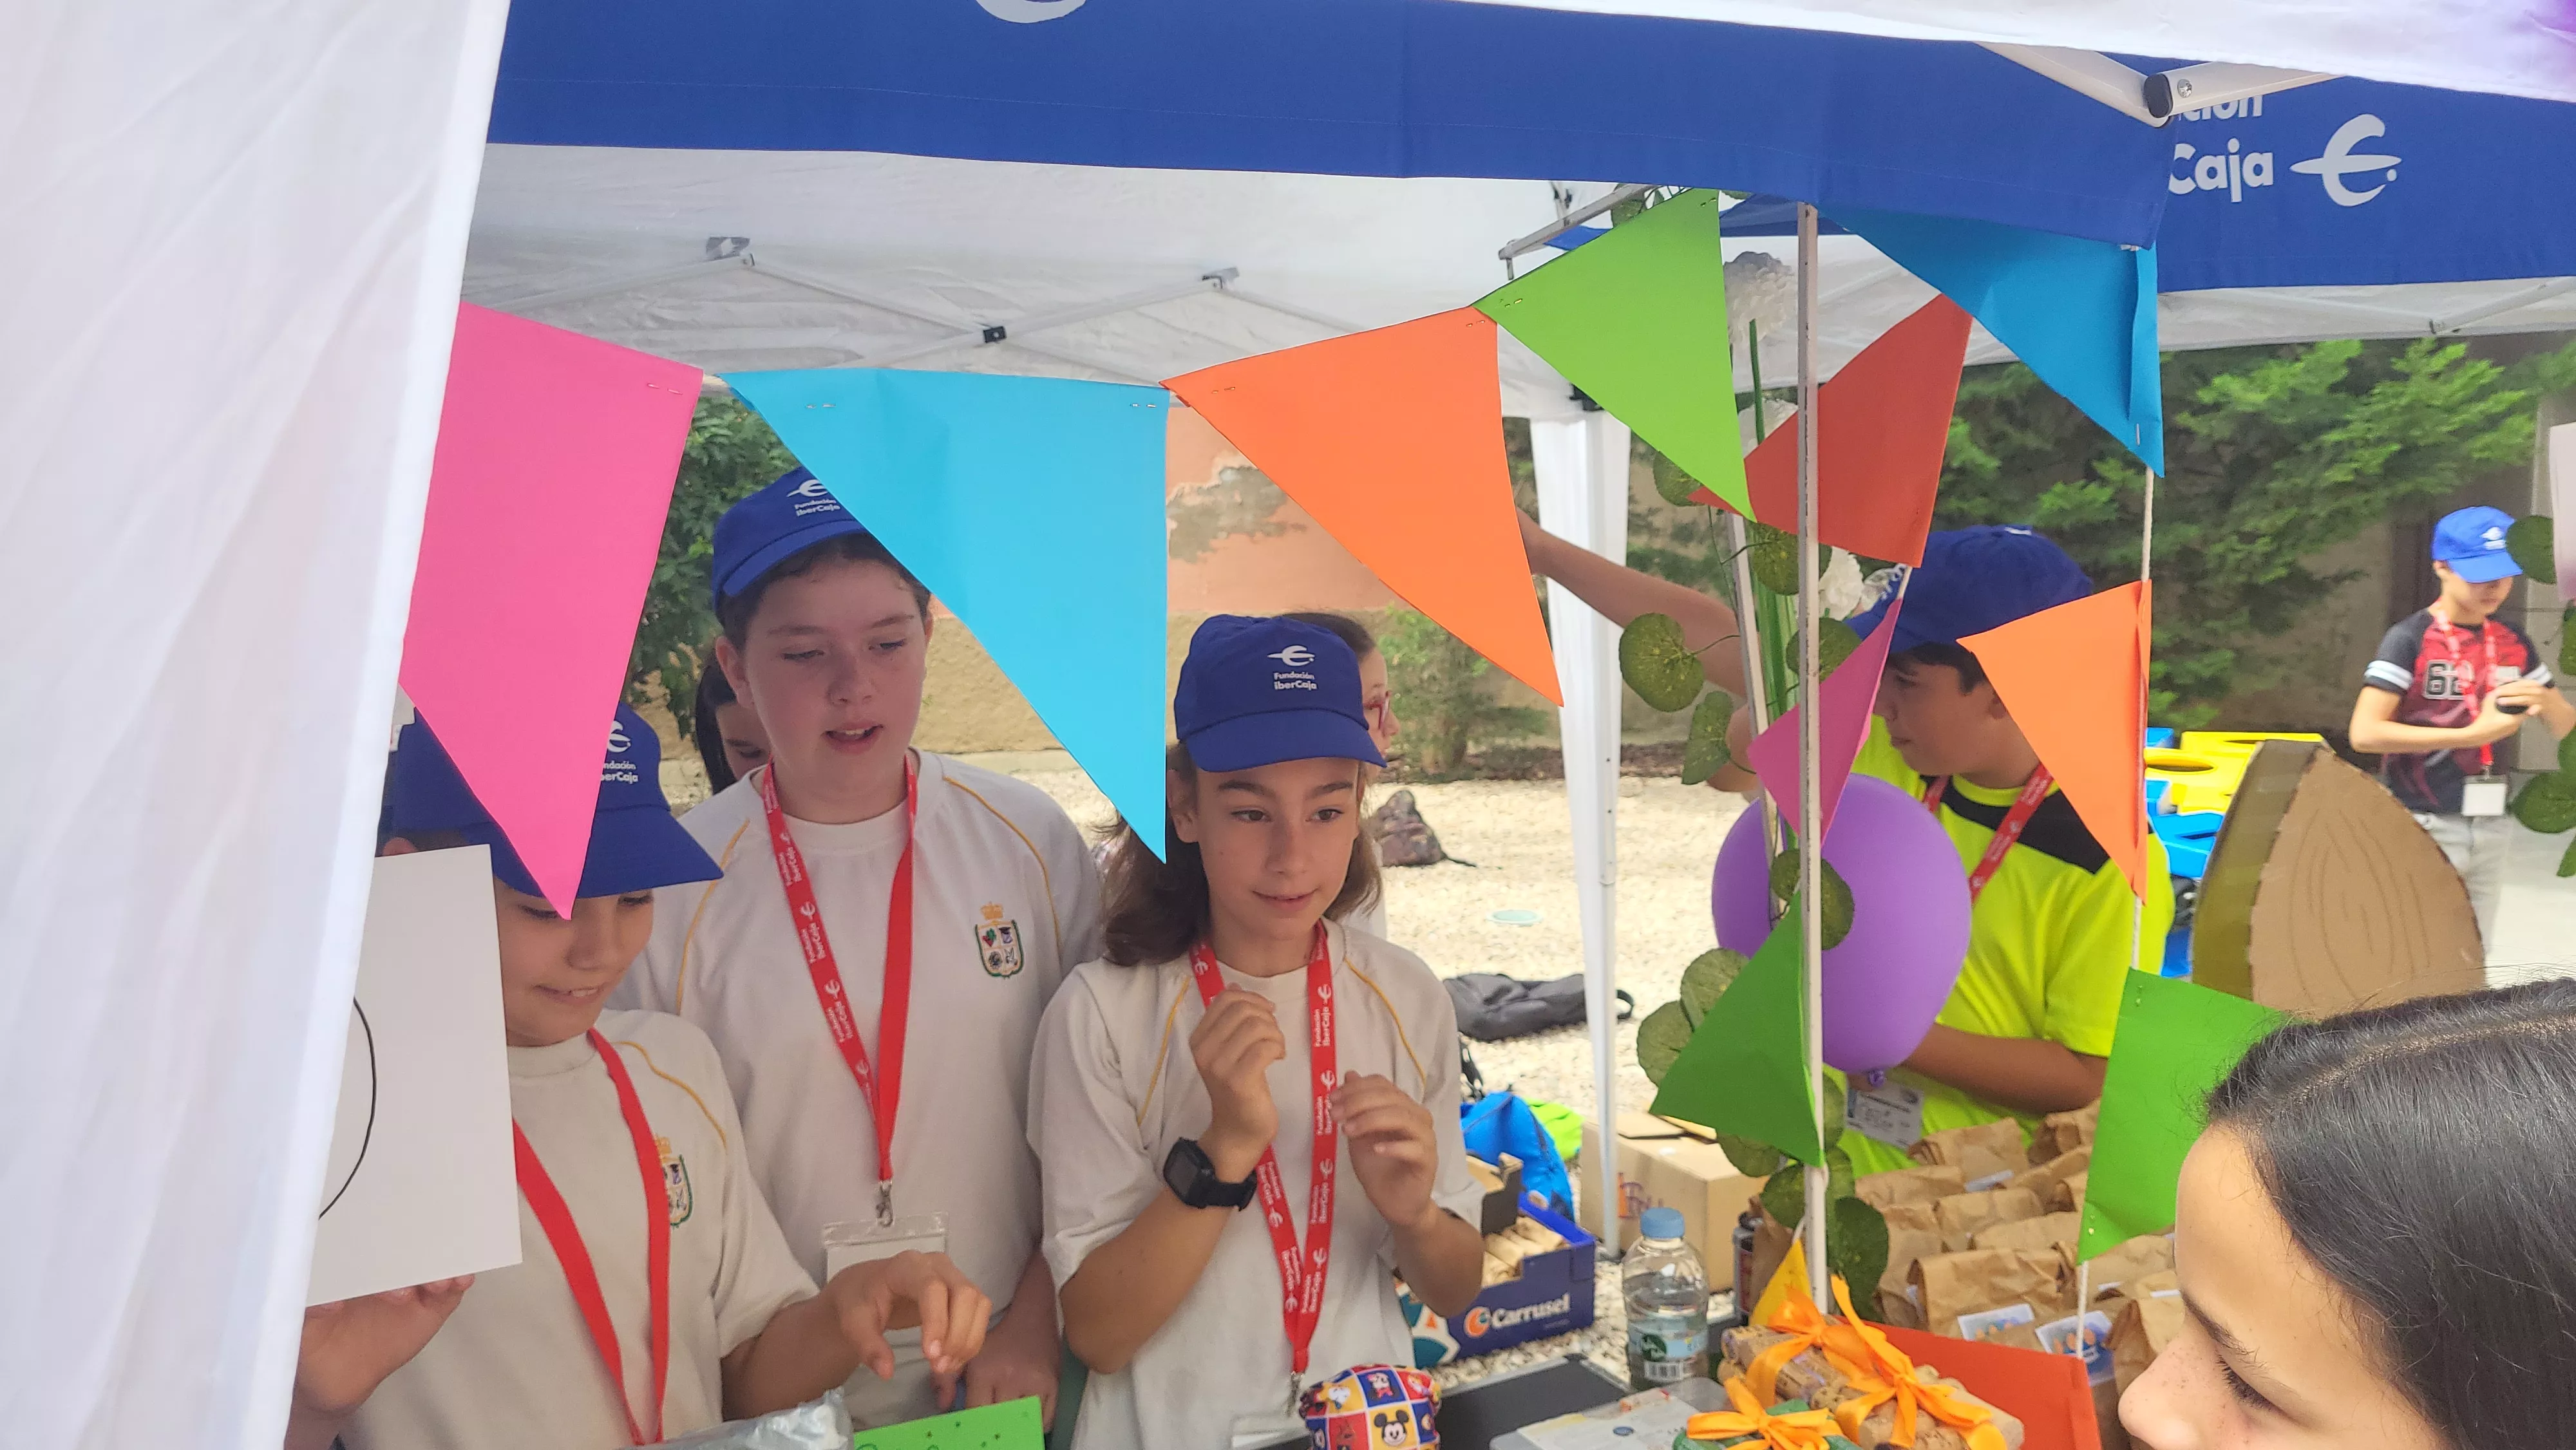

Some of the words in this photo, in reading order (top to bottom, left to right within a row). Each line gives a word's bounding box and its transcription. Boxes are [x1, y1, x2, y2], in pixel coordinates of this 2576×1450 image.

[2168, 137, 2274, 203] Caja
[1273, 670, 1315, 681] Fundación
[1492, 1292, 1571, 1330] Carrusel
